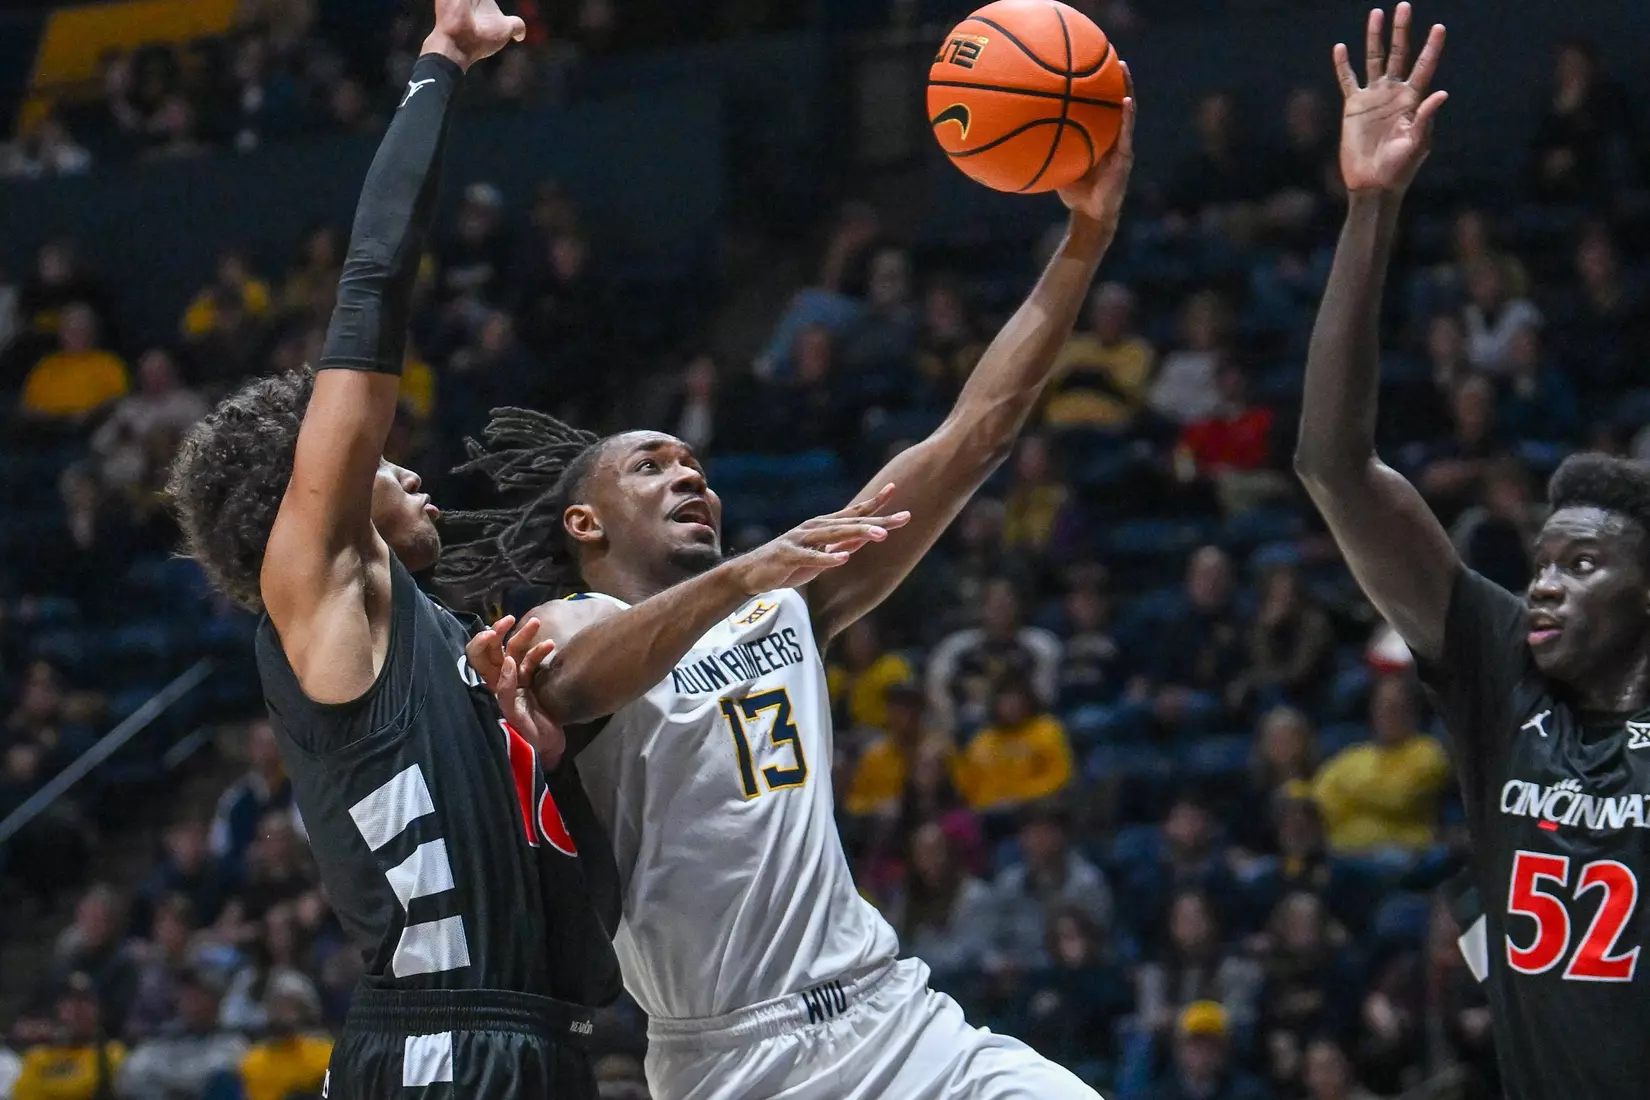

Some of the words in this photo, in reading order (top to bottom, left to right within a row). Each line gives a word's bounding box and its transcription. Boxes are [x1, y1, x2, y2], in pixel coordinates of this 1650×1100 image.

[671, 627, 804, 694] MOUNAINEERS
[718, 686, 809, 799] 13
[1505, 850, 1641, 982] 52
[802, 980, 848, 1025] WVU
